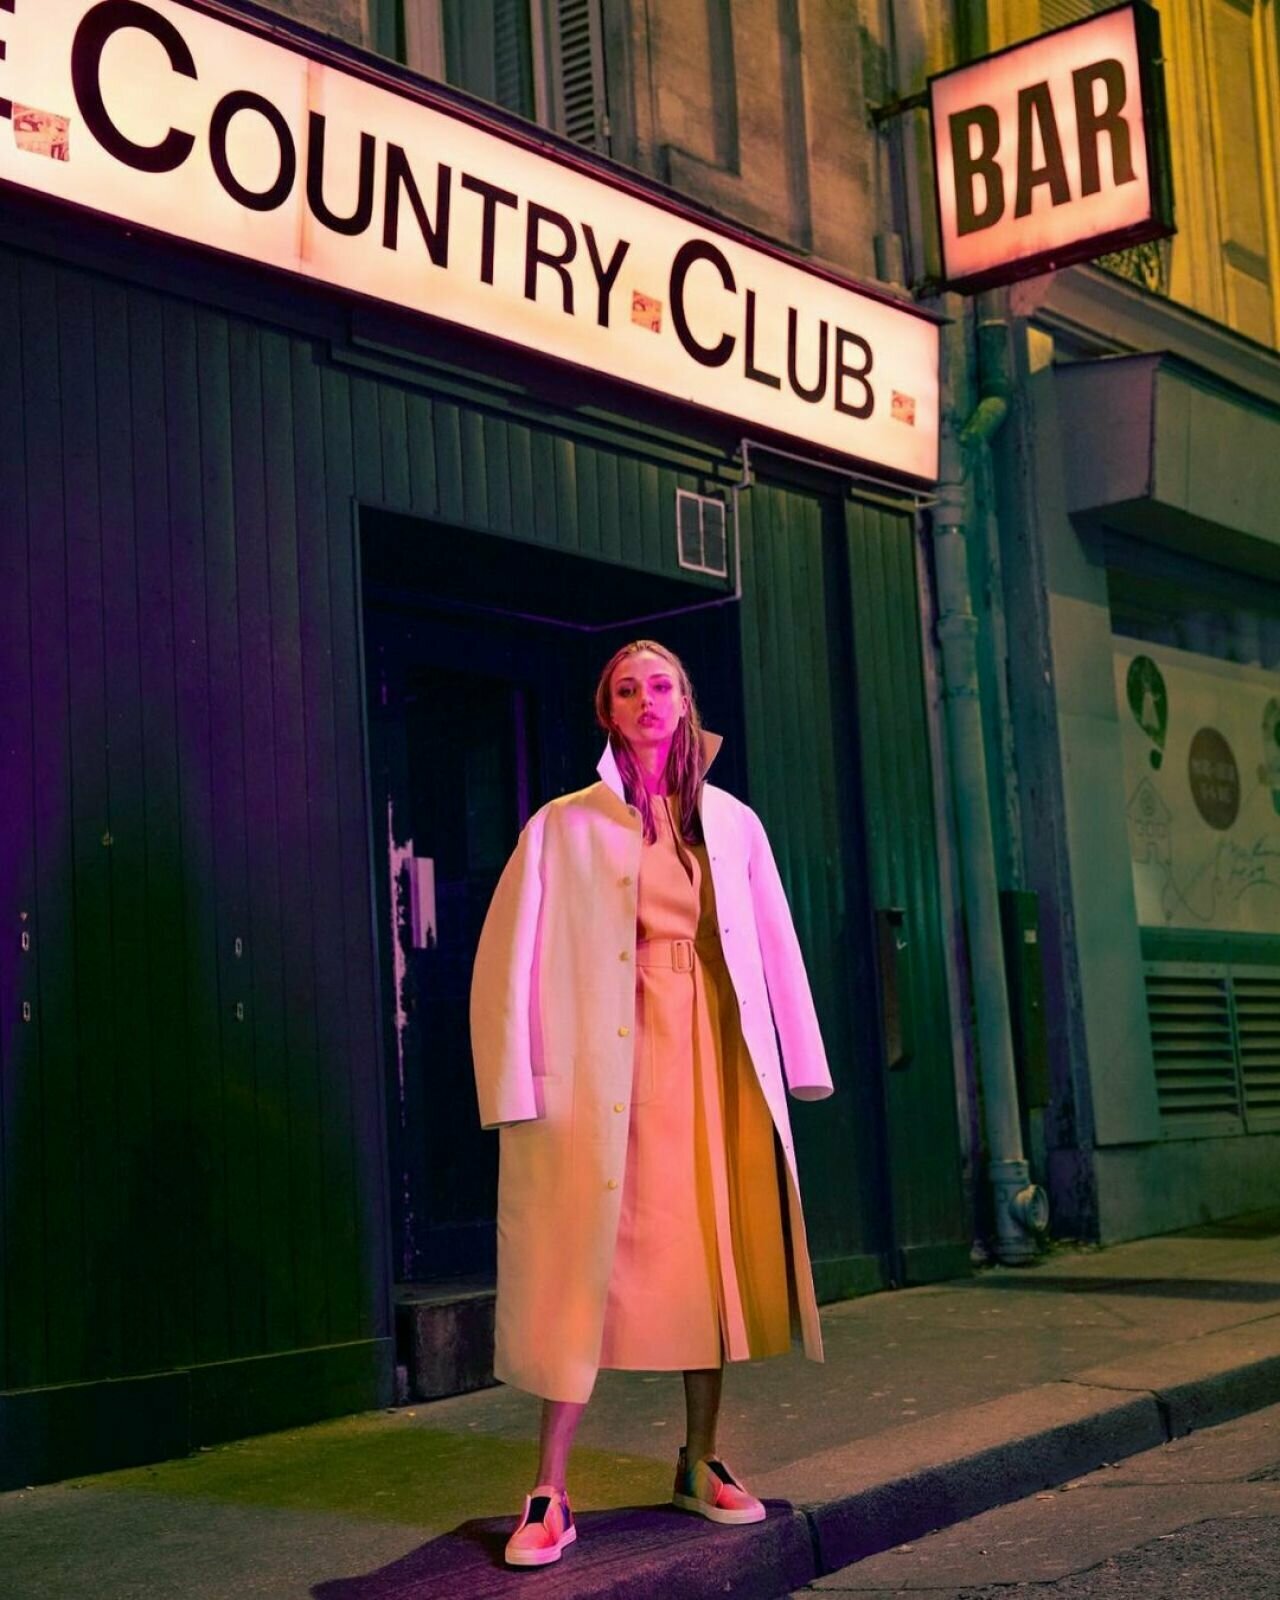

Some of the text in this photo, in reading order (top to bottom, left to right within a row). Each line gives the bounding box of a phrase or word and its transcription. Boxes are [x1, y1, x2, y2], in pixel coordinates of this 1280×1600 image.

[71, 0, 630, 328] COUNTRY
[669, 240, 874, 418] CLUB
[948, 58, 1137, 237] BAR
